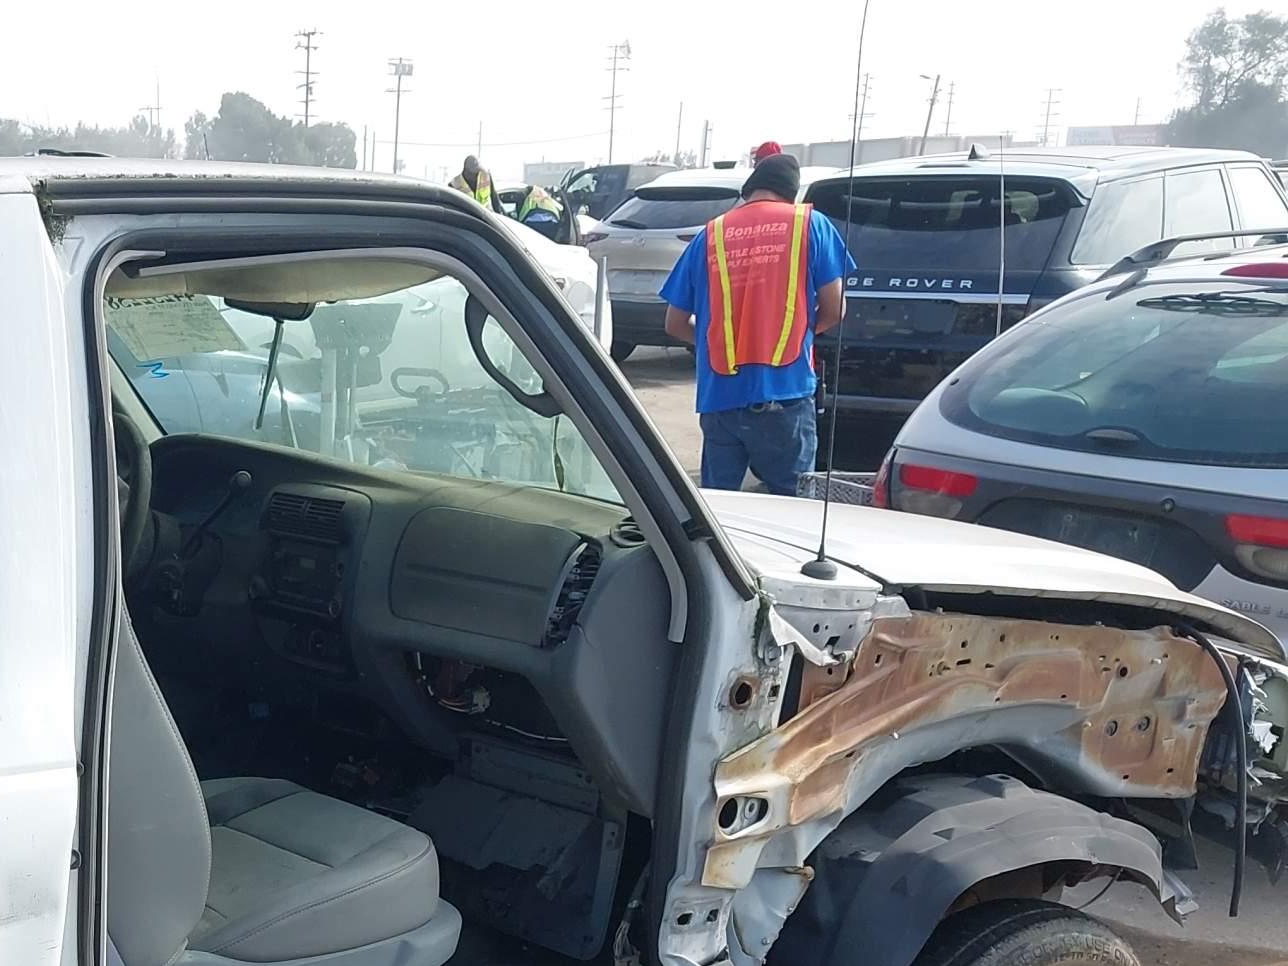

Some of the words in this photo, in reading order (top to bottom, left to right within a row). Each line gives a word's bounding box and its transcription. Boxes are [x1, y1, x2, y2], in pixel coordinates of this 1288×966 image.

[725, 222, 789, 239] Bonanza
[755, 243, 786, 255] STONE
[889, 278, 973, 289] ROVER
